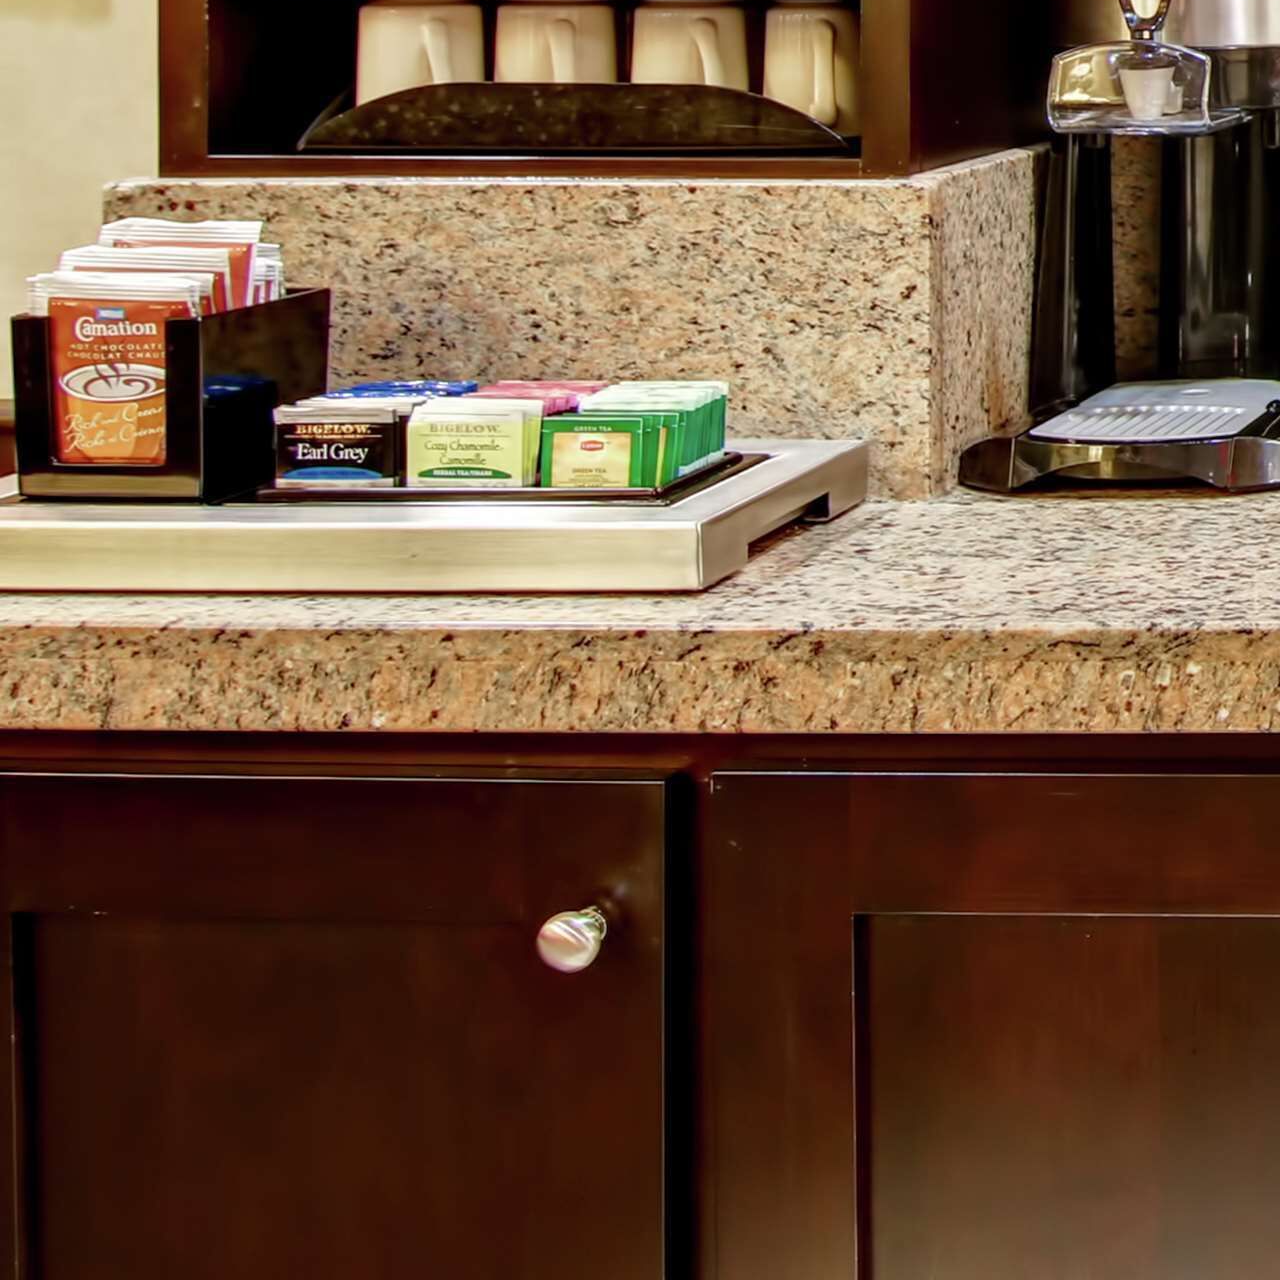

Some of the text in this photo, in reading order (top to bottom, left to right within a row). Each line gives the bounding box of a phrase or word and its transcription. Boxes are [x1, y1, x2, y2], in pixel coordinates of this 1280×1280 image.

[75, 316, 157, 341] Carnation
[67, 351, 122, 360] CHOCOLAT
[295, 424, 370, 434] BIGELOW
[429, 423, 501, 433] BIGELOW
[296, 443, 369, 463] Earl Grey
